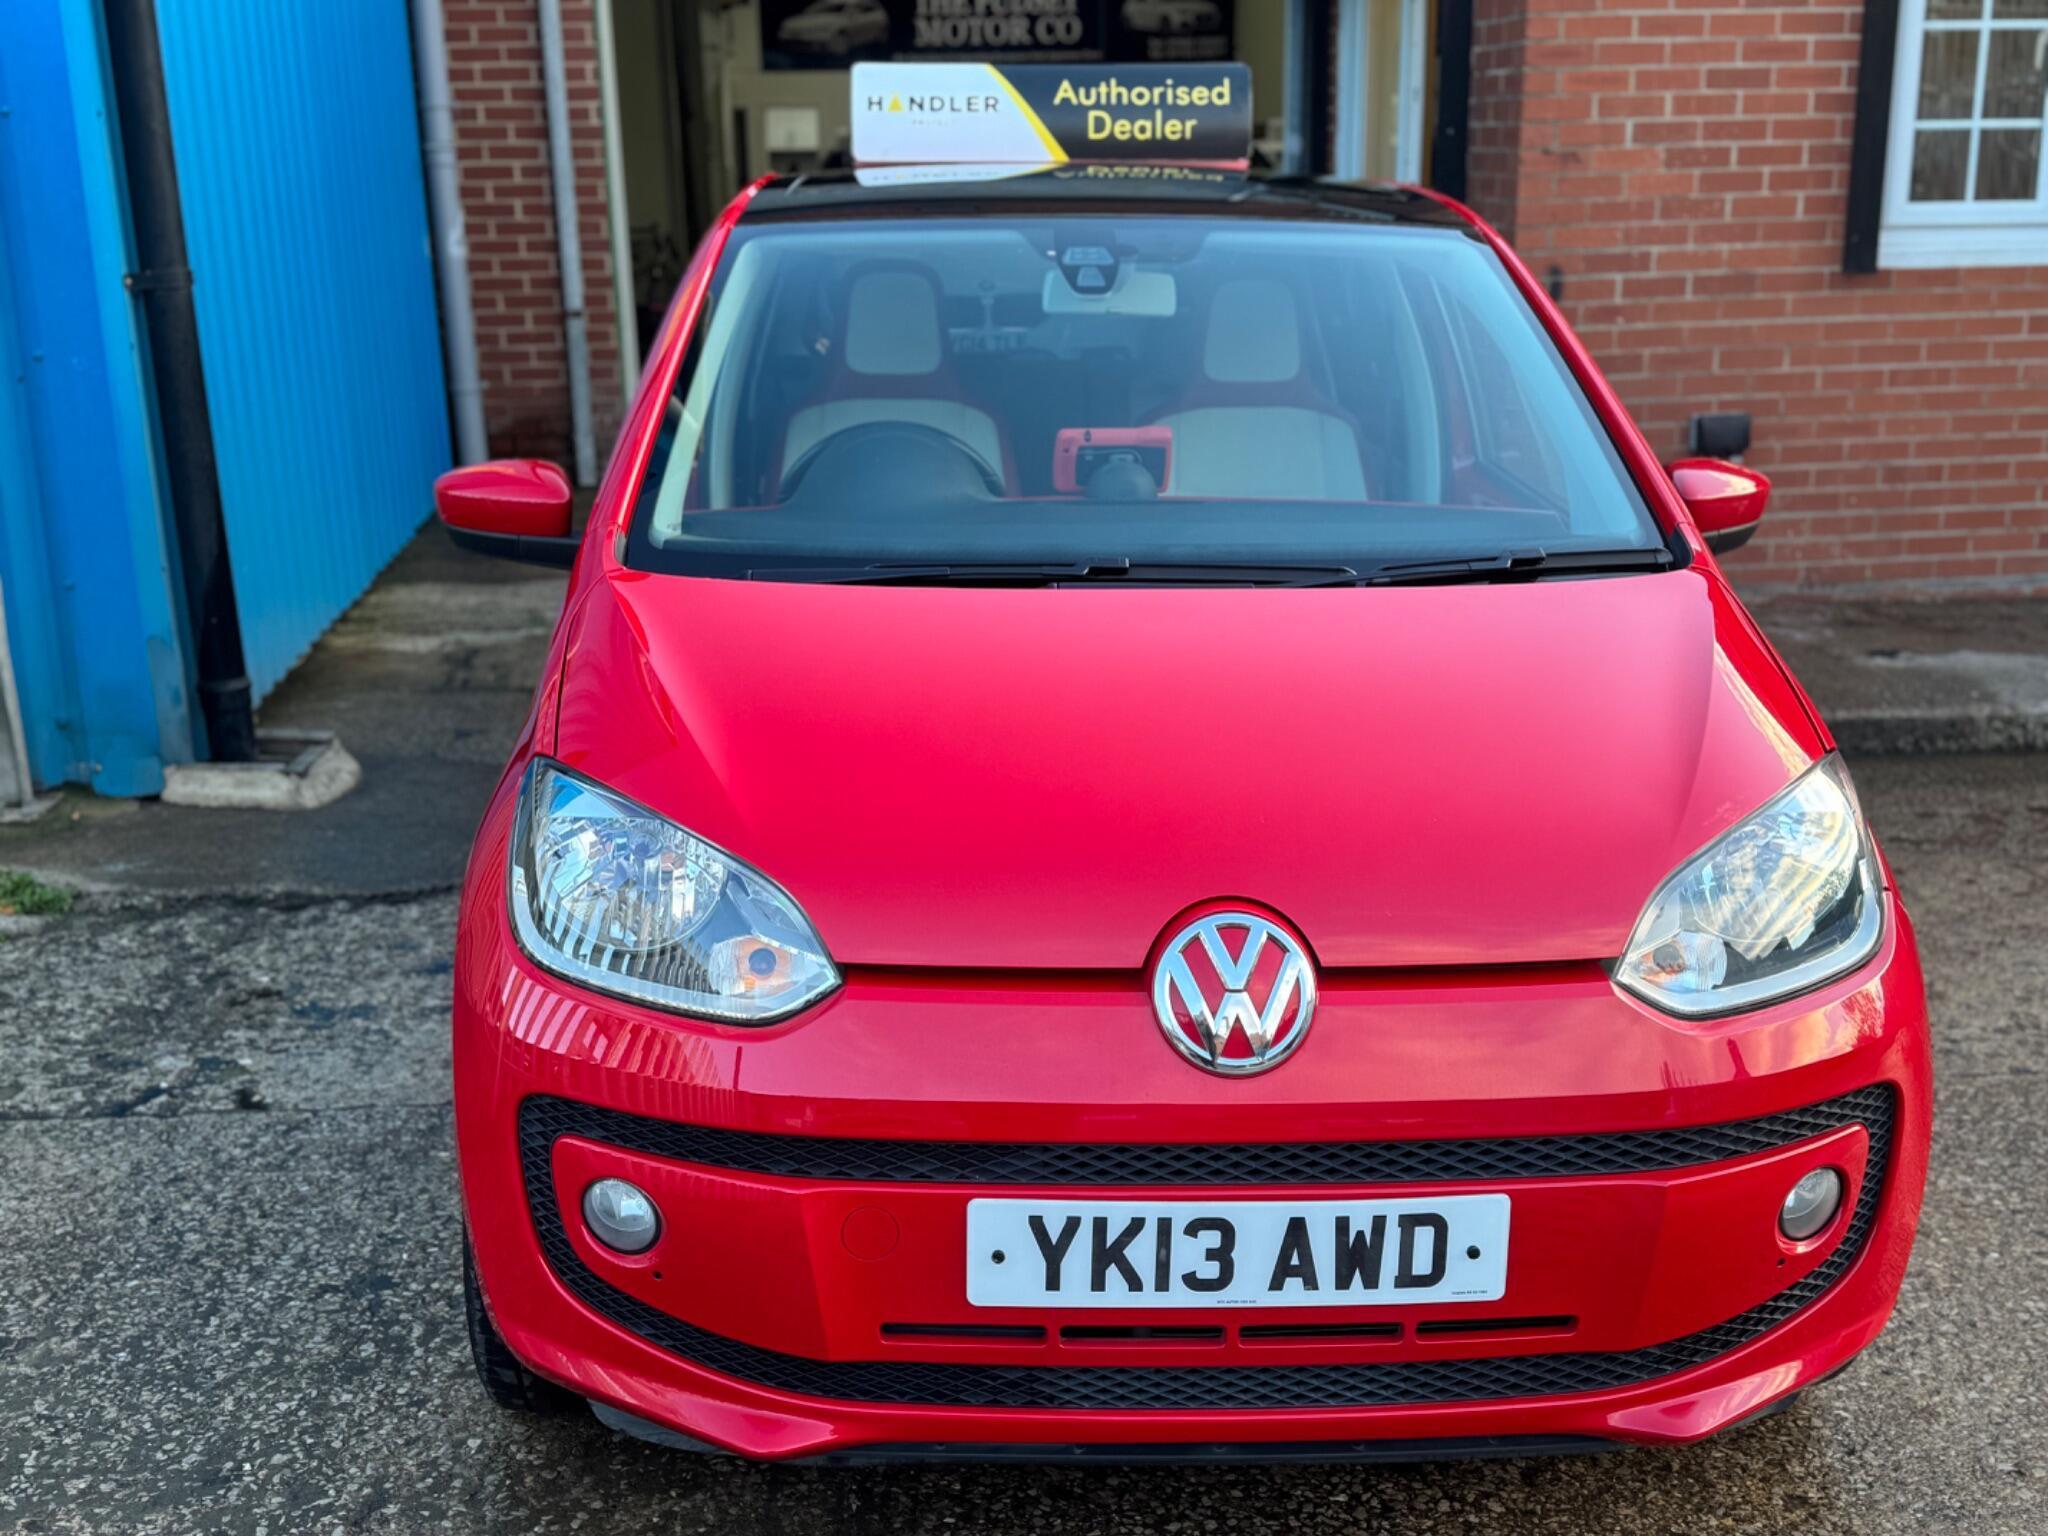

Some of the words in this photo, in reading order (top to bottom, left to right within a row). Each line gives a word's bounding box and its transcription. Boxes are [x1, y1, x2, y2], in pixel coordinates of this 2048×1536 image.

[914, 16, 1033, 47] MOTOR
[1034, 15, 1083, 46] CO
[867, 91, 1000, 112] HANDLER
[1052, 76, 1231, 107] Authorised
[1087, 108, 1199, 141] Dealer
[1028, 1214, 1236, 1293] YK13
[1267, 1212, 1449, 1292] AWD
